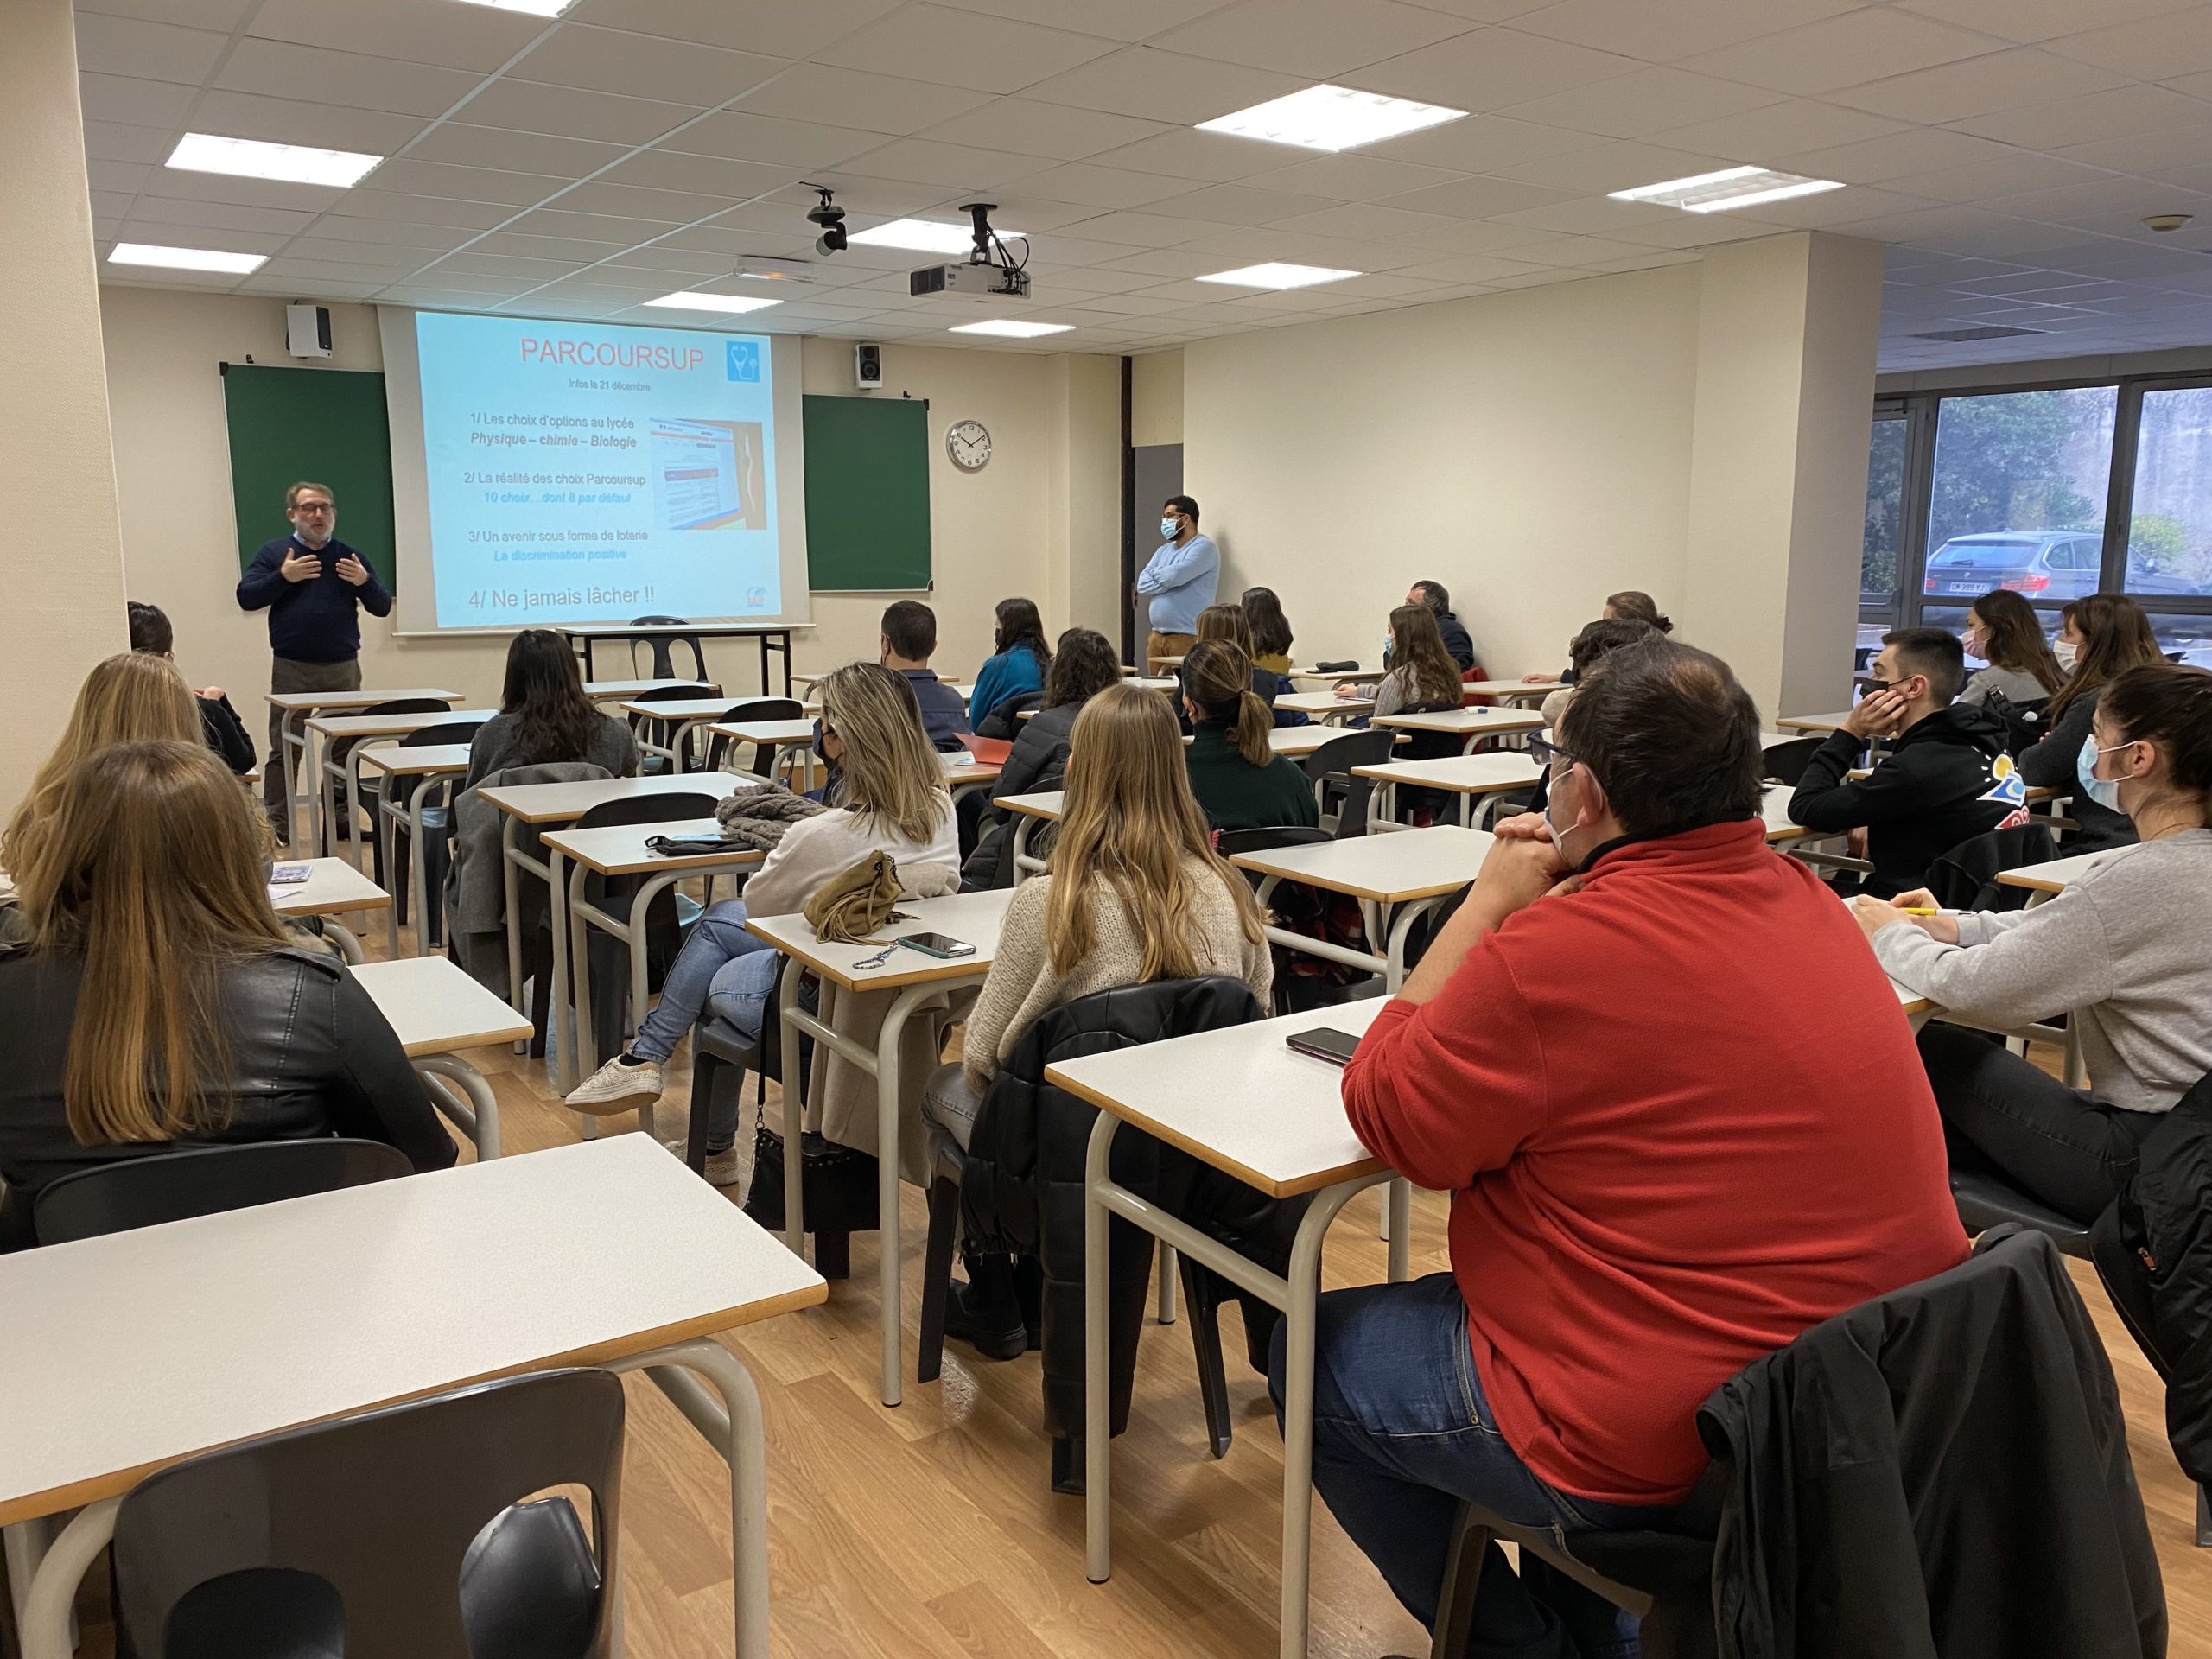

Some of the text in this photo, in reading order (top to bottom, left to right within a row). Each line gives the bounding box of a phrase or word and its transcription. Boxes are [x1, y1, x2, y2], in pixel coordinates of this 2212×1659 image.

[522, 338, 704, 371] PARCOURSUP
[569, 378, 651, 391] Infos le 21 décembre
[470, 412, 635, 431] 1/ Les choix d'options au lycée
[470, 432, 526, 447] Physique
[539, 434, 578, 447] chimie
[590, 435, 637, 450] Biologie
[464, 472, 646, 487] 2/ La réalité des choix Parcoursup
[484, 492, 498, 503] 10
[578, 493, 596, 505] par
[598, 492, 632, 503] défaut
[468, 530, 648, 543] 3/ Un avenir sous forme de loterie
[494, 550, 627, 562] La discrimination positive
[468, 590, 486, 608] 4/
[492, 589, 518, 607] Ne
[523, 588, 582, 611] jamais
[587, 586, 639, 605] lâcher
